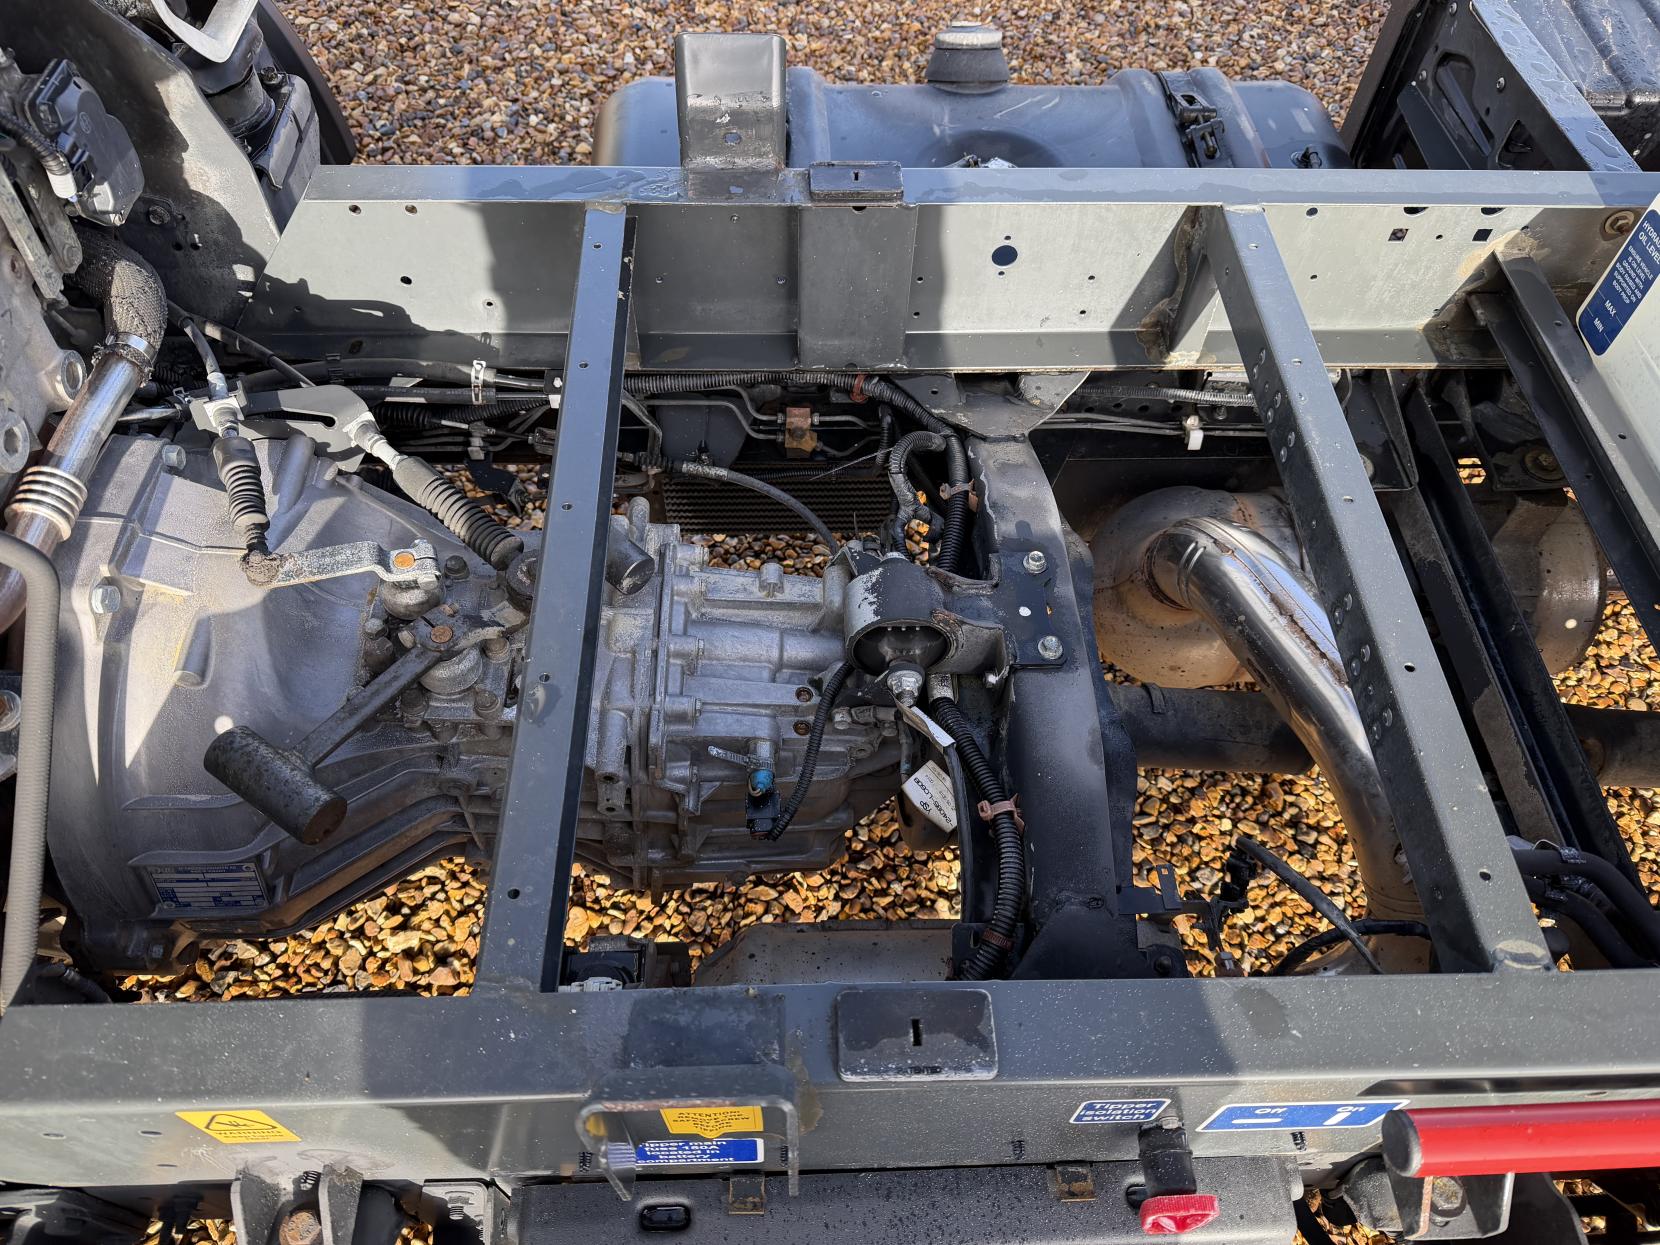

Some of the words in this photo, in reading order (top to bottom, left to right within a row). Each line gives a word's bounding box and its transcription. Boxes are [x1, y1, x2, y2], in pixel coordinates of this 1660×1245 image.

[1639, 232, 1648, 246] OIL
[1646, 241, 1660, 265] LEVEL
[1628, 245, 1642, 264] ENSURE
[1640, 261, 1654, 280] VEHICLE
[1636, 267, 1646, 282] LEVEL
[1613, 270, 1631, 295] SUPPORTED
[1616, 262, 1625, 275] BODY
[1624, 274, 1635, 291] RAISED
[1634, 289, 1642, 299] AND
[1622, 260, 1636, 280] GROUND
[1635, 276, 1644, 290] WITH
[1612, 280, 1622, 293] BODY
[1620, 292, 1630, 304] PROP
[1604, 300, 1617, 317] MAX
[1593, 317, 1605, 333] MIN
[920, 800, 933, 815] YSP
